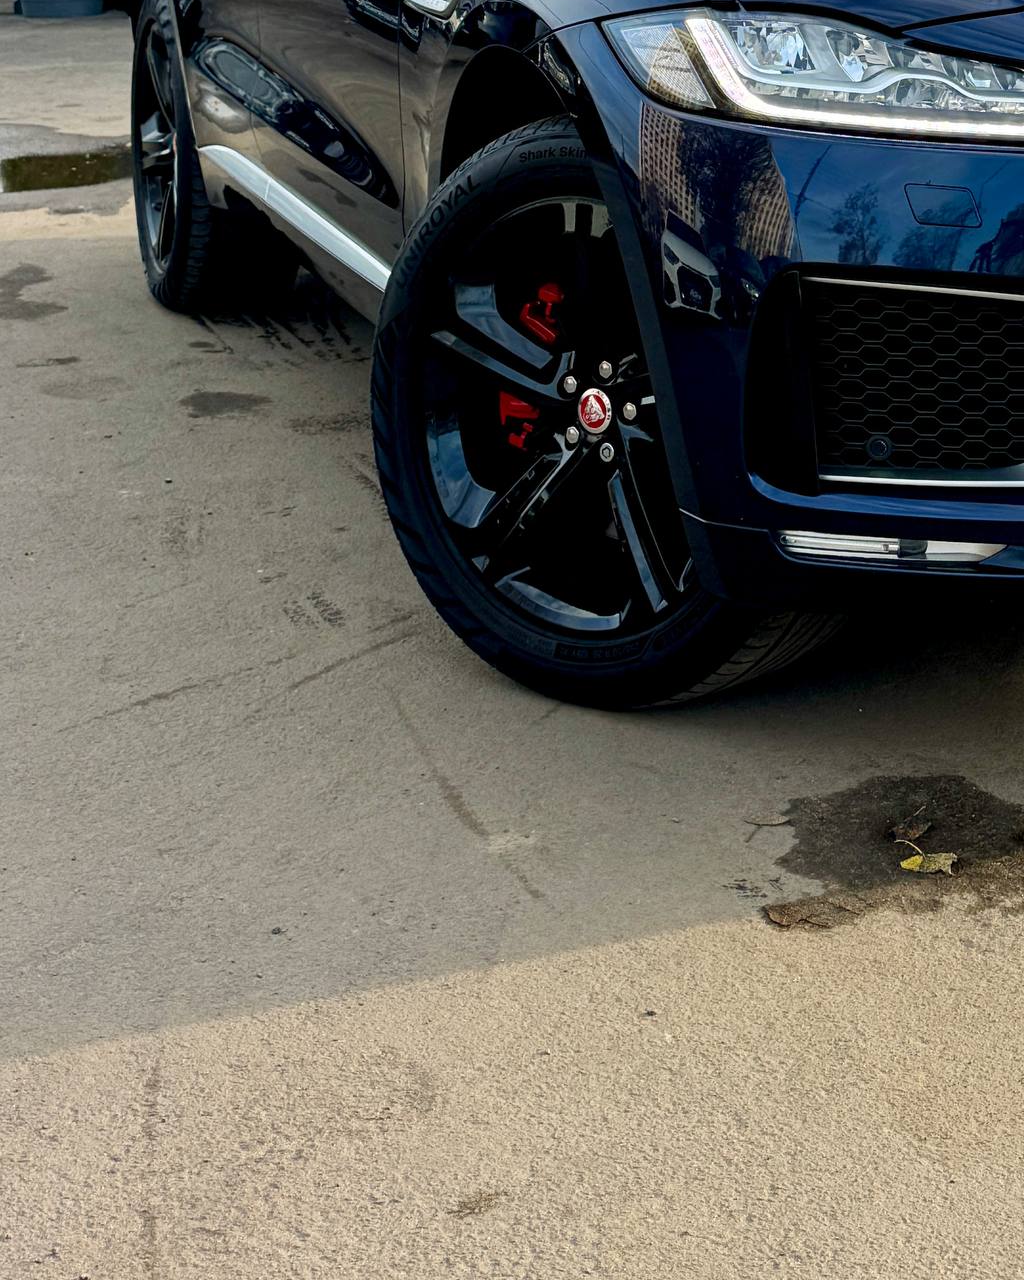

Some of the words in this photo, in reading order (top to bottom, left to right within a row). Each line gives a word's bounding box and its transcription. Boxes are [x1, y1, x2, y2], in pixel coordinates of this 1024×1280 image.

[519, 147, 556, 163] Shark
[559, 146, 590, 160] Skin
[396, 175, 482, 290] UNIROYAL
